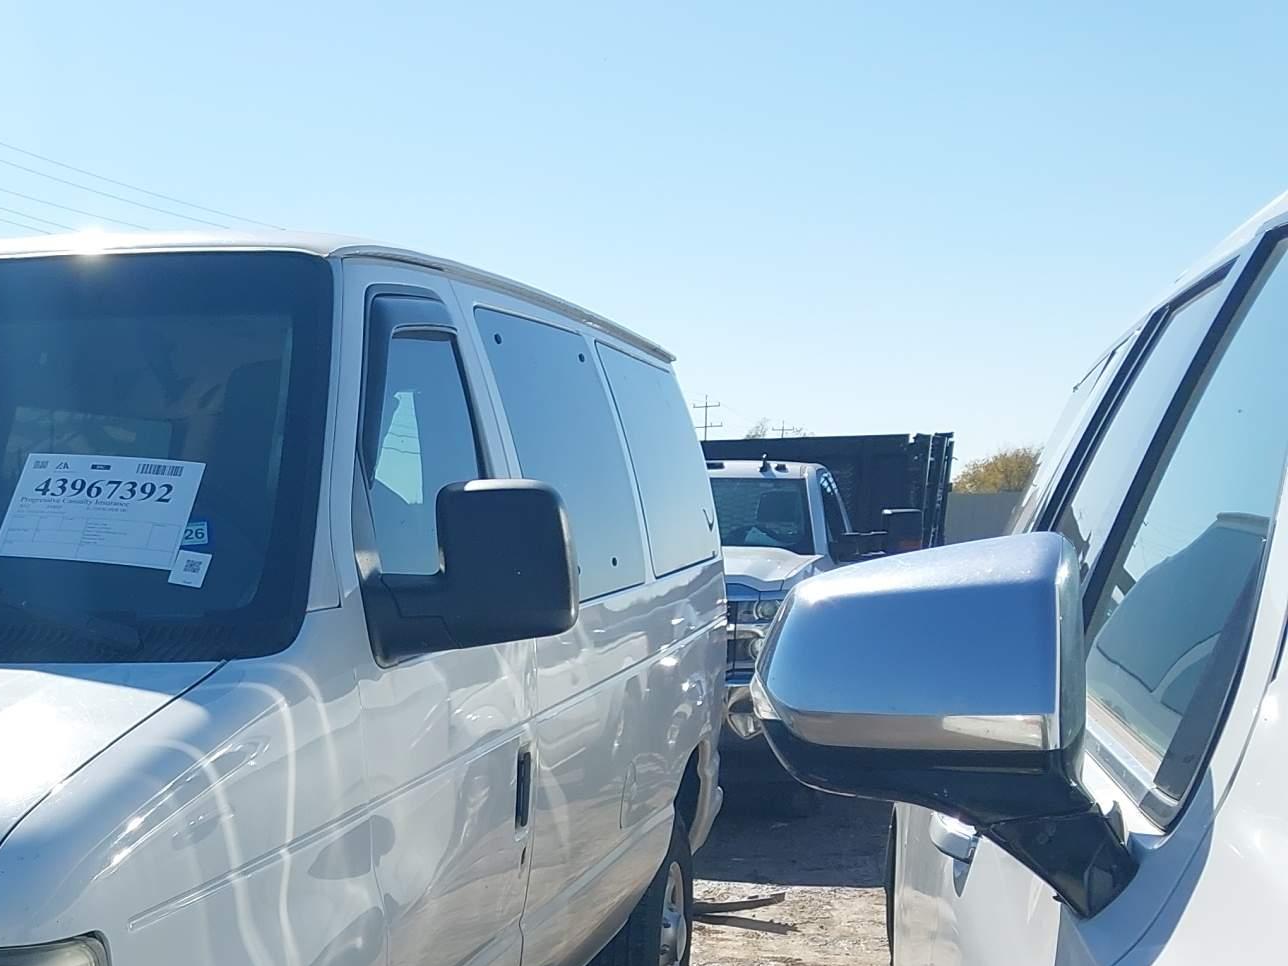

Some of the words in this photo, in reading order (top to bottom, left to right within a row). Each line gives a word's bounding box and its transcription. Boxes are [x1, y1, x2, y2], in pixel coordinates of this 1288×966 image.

[34, 477, 174, 503] 43967392
[94, 499, 130, 507] Insurance
[184, 528, 205, 541] 26
